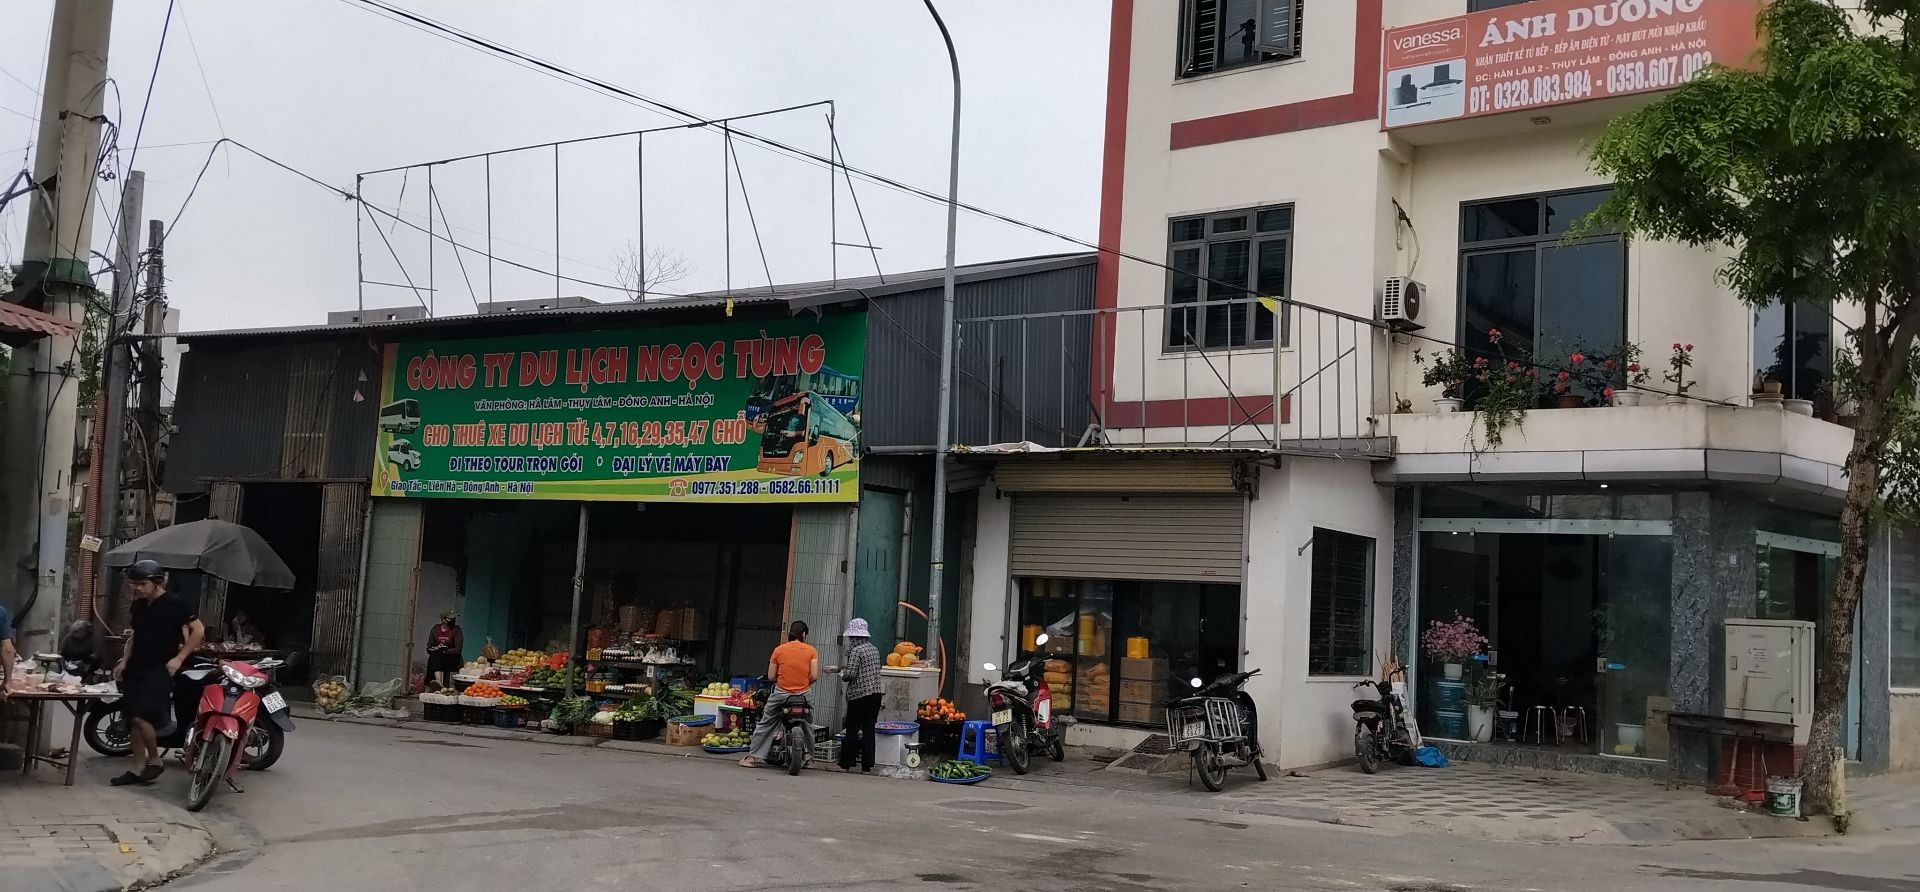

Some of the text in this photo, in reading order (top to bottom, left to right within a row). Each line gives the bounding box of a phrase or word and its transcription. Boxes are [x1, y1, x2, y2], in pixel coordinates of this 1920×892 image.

[1393, 27, 1461, 51] vanessa
[1479, 13, 1557, 48] ÁNH
[1535, 41, 1549, 57] BẾP
[1616, 29, 1632, 44] MÁY
[1475, 73, 1492, 82] ĐC:
[1515, 65, 1536, 76] LÂM
[1537, 64, 1544, 73] 2
[1552, 58, 1577, 71] THỤY
[1579, 55, 1601, 66] LÂM
[1608, 48, 1638, 62] ĐÔNG
[1640, 45, 1663, 57] ANH
[1671, 41, 1686, 52] HÀ
[1688, 38, 1707, 50] NỘI
[1469, 84, 1490, 113] ĐT:
[1494, 69, 1593, 110] 0328.083.984
[406, 329, 826, 393] CÔNG TY DU LỊCH NGỌC TÙNG
[493, 397, 528, 411] PHÒNG:
[528, 396, 543, 410] HÀ
[543, 396, 562, 409] LÂM
[567, 397, 591, 411] THỤY
[591, 395, 613, 408] LÂM
[618, 394, 648, 408] ĐÔNG
[648, 395, 671, 407] ANH
[677, 392, 693, 407] HÀ
[694, 391, 714, 408] NỘI
[423, 424, 449, 447] CHO
[452, 421, 485, 446] THUÊ
[487, 423, 506, 446] XE
[509, 423, 528, 446] DU
[531, 422, 563, 450] LỊCH
[567, 417, 589, 446] TỪ:
[591, 420, 710, 449] 4,7,16,29,35,47
[712, 410, 746, 445] CHỖ
[449, 457, 463, 472] ĐI
[464, 456, 493, 472] THEO
[494, 456, 526, 472] TOUR
[526, 456, 558, 475] TRỌN
[560, 452, 584, 472] GÓI
[613, 456, 635, 476] ĐẠI
[637, 453, 653, 472] LÝ
[673, 453, 703, 473] MÁY
[705, 455, 731, 473] BAY
[390, 480, 408, 491] Giao
[428, 481, 445, 492] Liên
[445, 481, 456, 492] Hà
[463, 482, 483, 494] Đông
[484, 482, 500, 493] Anh
[506, 482, 519, 493] Hà
[519, 481, 534, 496] Nội
[692, 479, 840, 495] 0977.351.288 0582.66.1111
